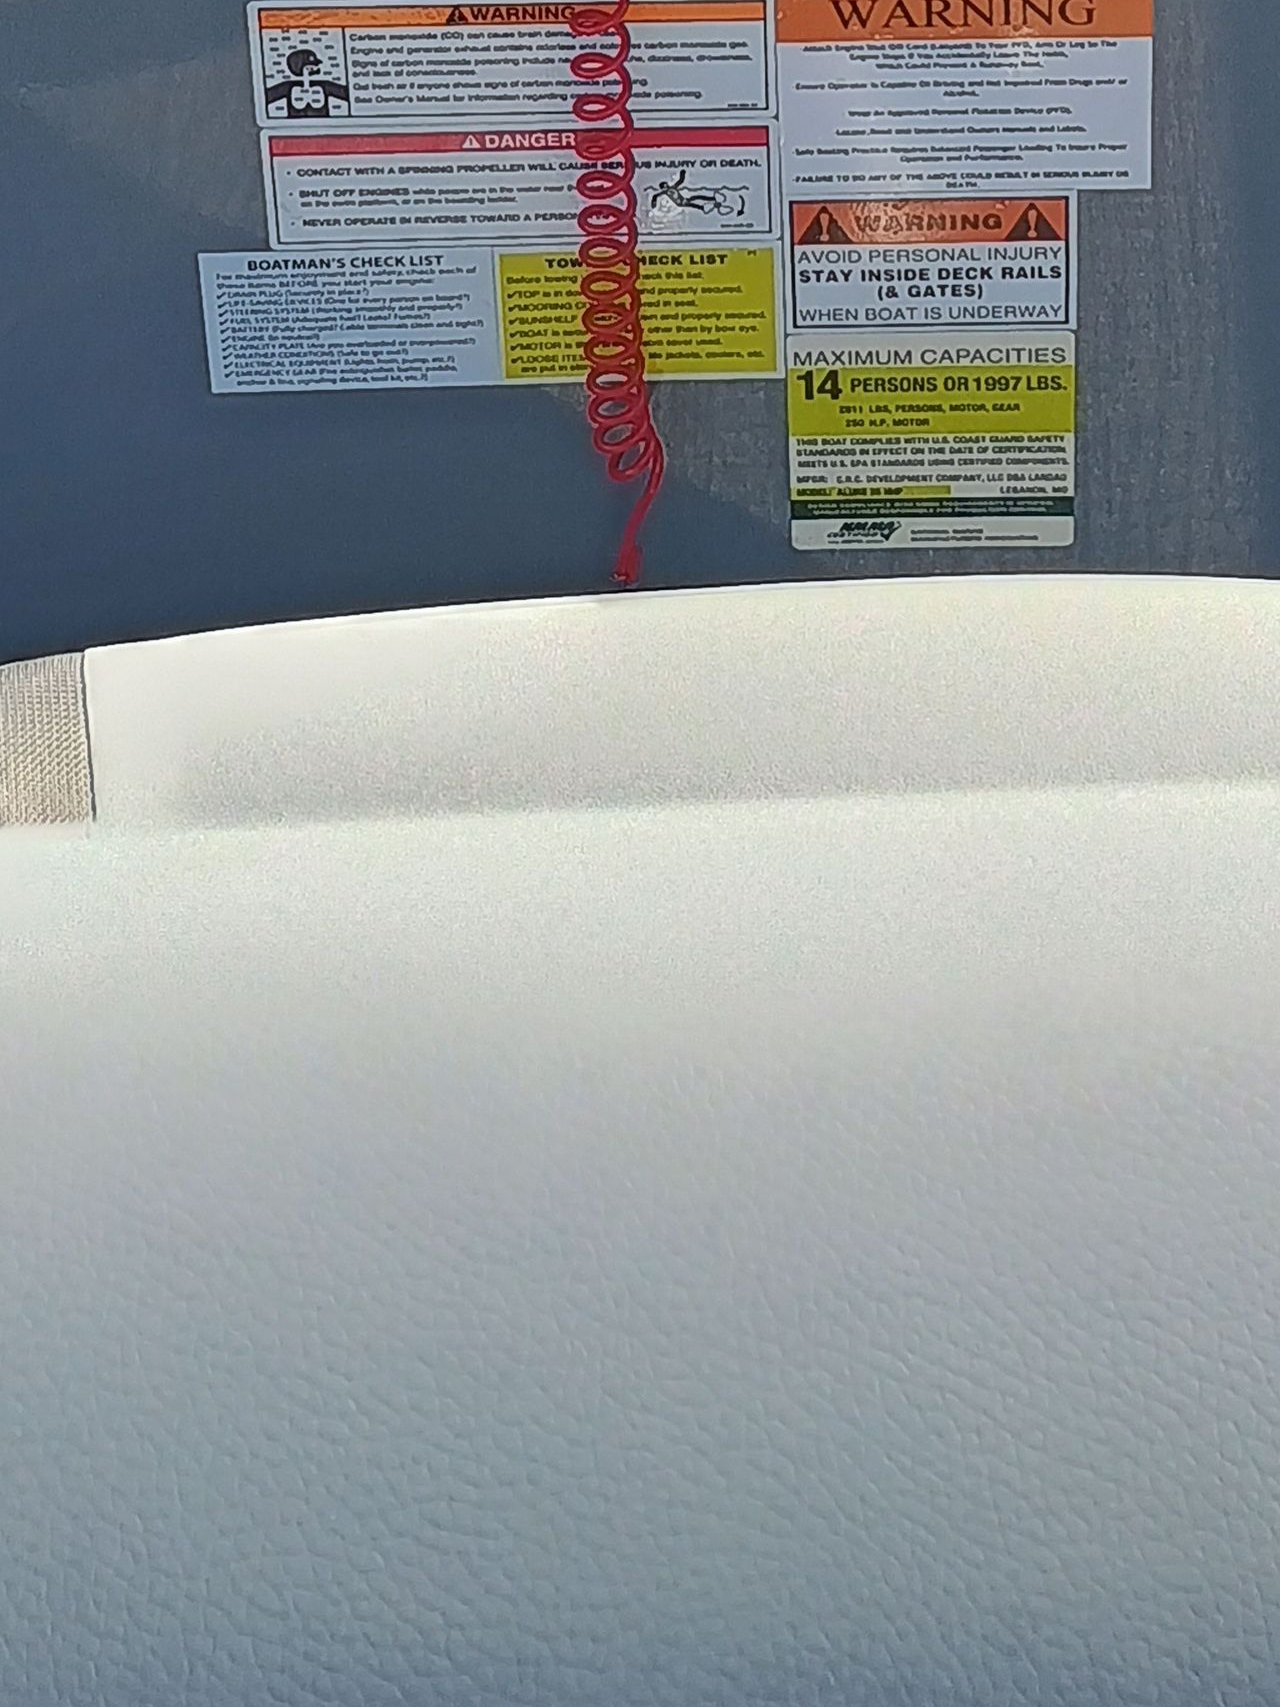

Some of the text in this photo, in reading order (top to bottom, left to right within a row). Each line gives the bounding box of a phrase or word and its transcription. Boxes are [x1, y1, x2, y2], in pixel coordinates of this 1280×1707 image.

[471, 7, 575, 21] WARNING
[485, 132, 576, 148] DANGER
[297, 167, 351, 177] CONTACT
[355, 167, 384, 176] WITH
[457, 164, 524, 174] PROPELLER
[528, 163, 554, 172] WILL
[655, 160, 695, 169] INJURY
[700, 160, 716, 168] OR
[720, 159, 761, 168] DEATH.
[299, 189, 329, 198] SHUT
[333, 189, 355, 197] OFF
[303, 218, 341, 227] NEVER
[344, 217, 396, 226] OPERATE
[415, 215, 467, 225] REVERSE
[471, 214, 520, 223] TOWARD
[524, 214, 532, 222] A
[855, 213, 1002, 234] WARNING
[690, 254, 728, 266] LIST
[798, 246, 1061, 263] AVOID PERSONAL INJURY
[247, 255, 444, 271] BOATMAN'S CHECK LIST
[799, 266, 1061, 283] STAY INSIDE DECK RAILS
[878, 284, 983, 301] (& GATES)
[799, 304, 1062, 321] WHEN BOAT IS UNDERWAY
[793, 347, 1067, 366] MAXIMUM CAPACITIES
[796, 370, 1067, 400] 14 PERSONS OR 1997 LBS.
[895, 403, 946, 414] PERSONS,
[949, 403, 989, 413] MOTOR,
[992, 403, 1020, 412] GEAR
[892, 418, 930, 426] MOTOR
[850, 437, 900, 445] COMPLIES
[953, 436, 986, 444] COAST
